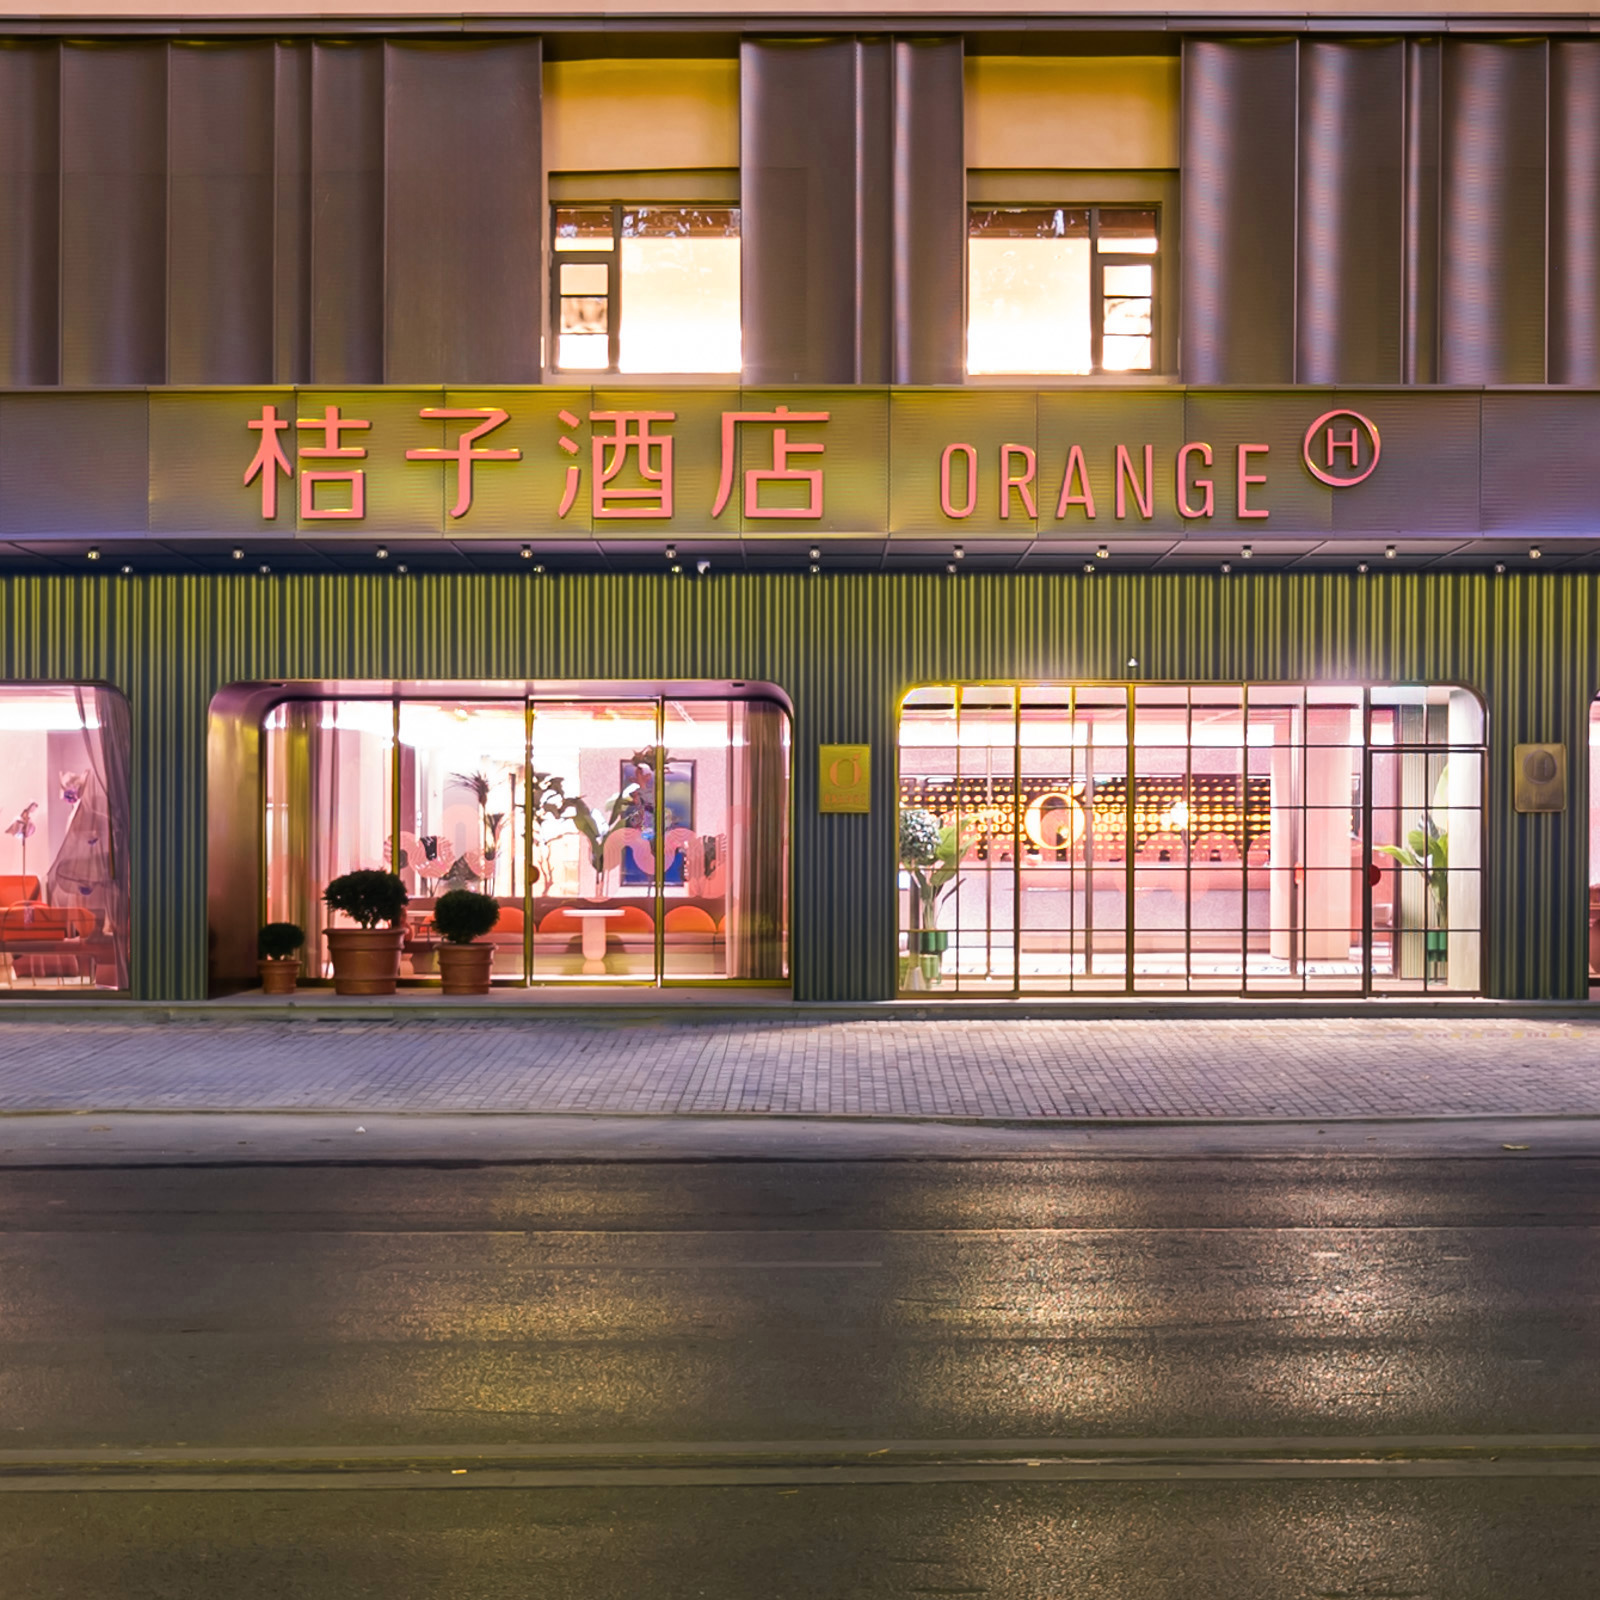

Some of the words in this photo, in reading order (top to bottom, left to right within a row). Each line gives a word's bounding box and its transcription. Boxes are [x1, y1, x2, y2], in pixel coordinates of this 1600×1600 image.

[243, 405, 831, 519] 桔子酒店
[940, 442, 1270, 519] ORANGE
